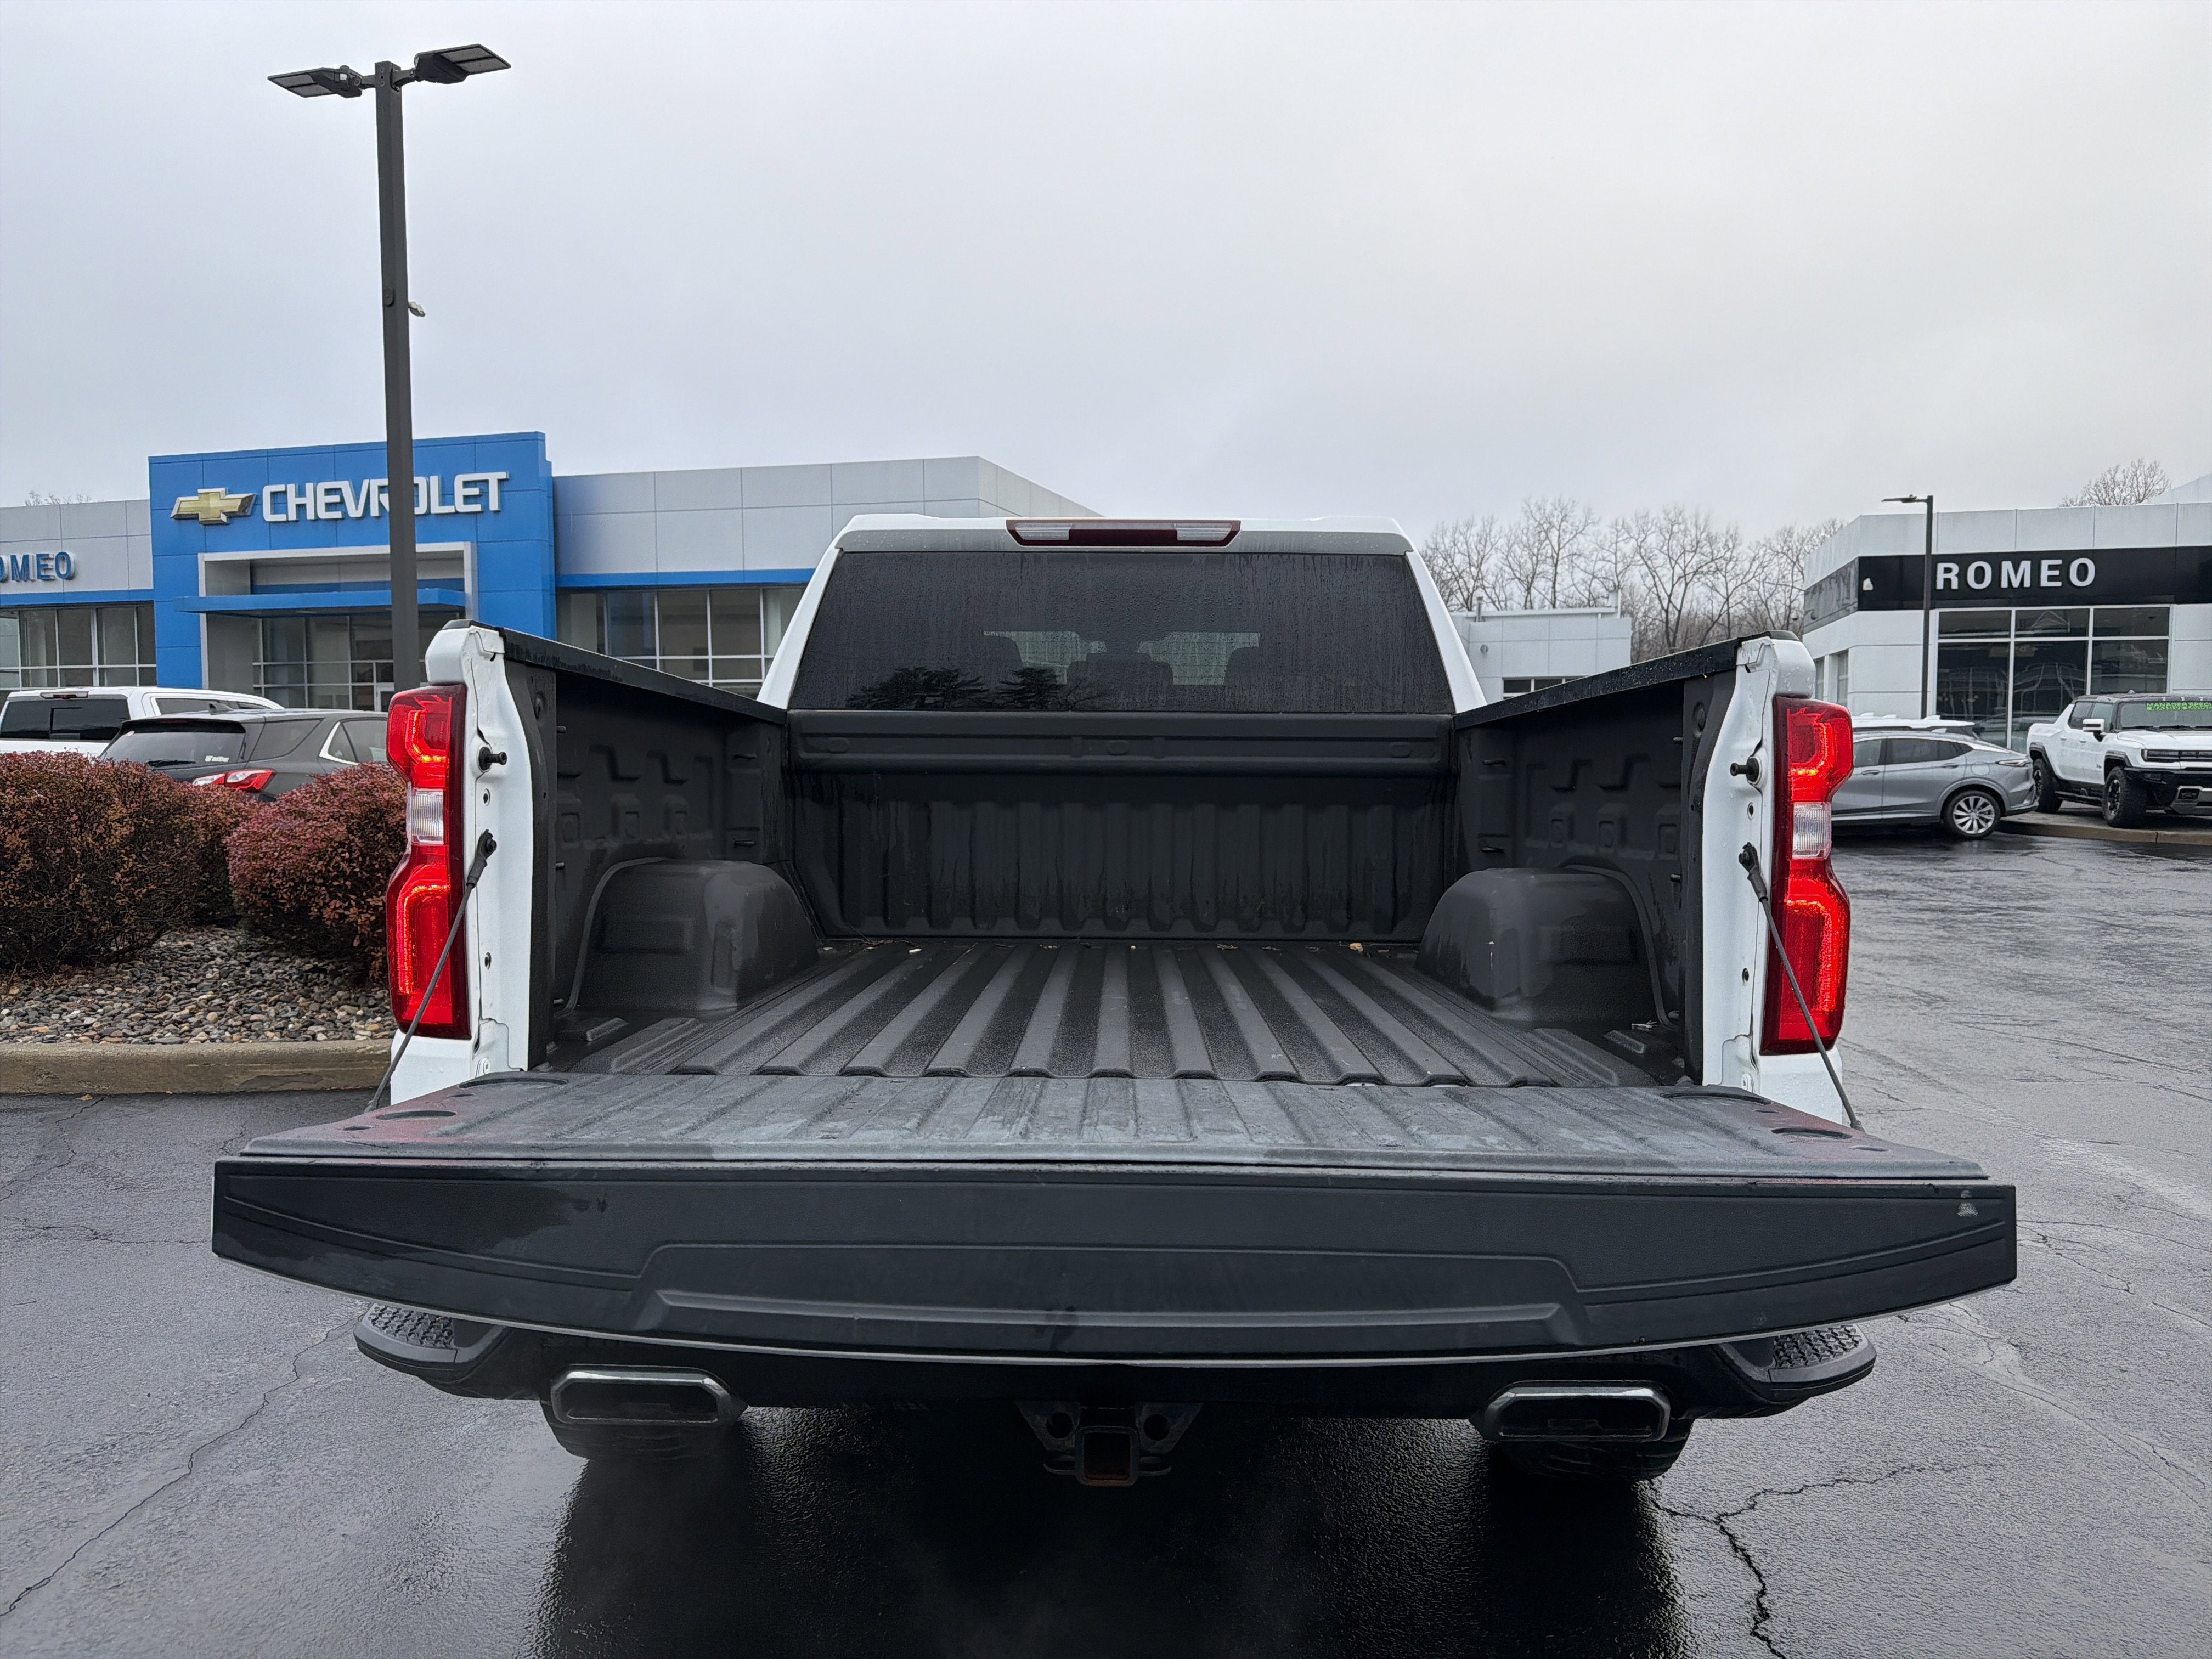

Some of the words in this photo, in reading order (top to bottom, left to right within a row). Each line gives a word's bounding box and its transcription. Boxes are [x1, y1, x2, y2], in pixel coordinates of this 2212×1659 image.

[263, 472, 509, 522] CHEVROLET
[0, 551, 74, 582] MEO
[1936, 558, 2095, 590] ROMEO
